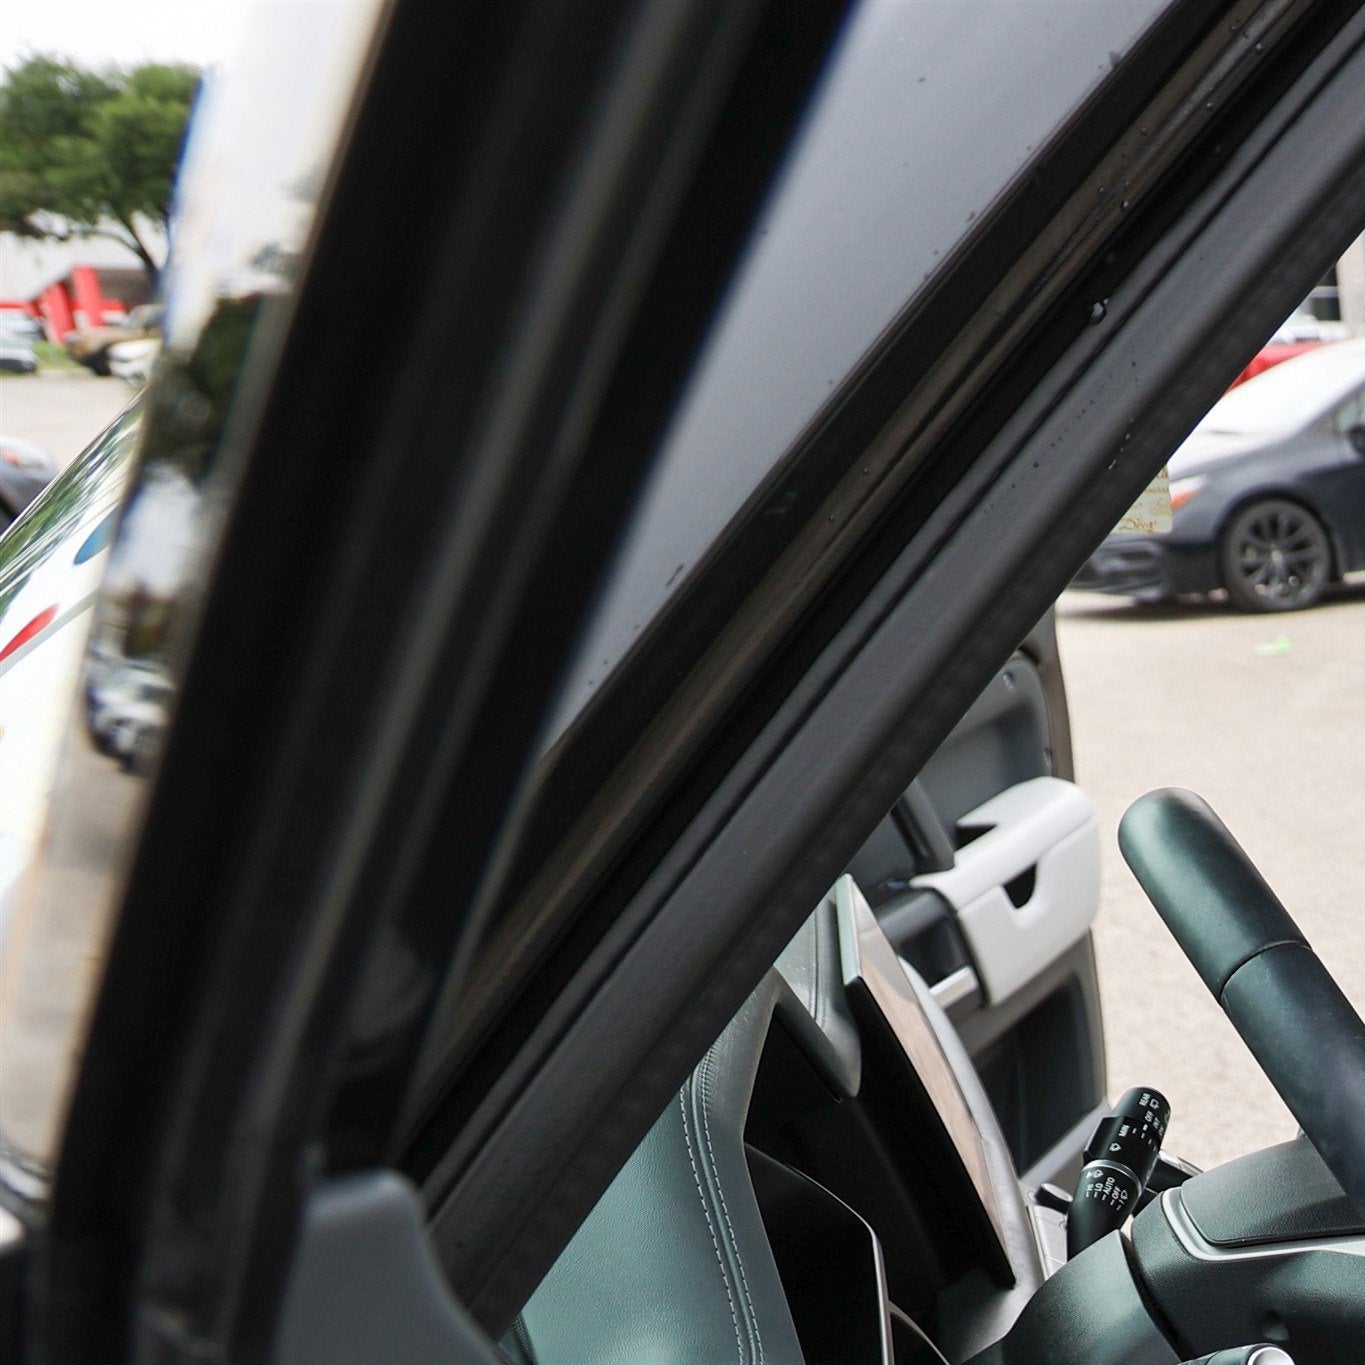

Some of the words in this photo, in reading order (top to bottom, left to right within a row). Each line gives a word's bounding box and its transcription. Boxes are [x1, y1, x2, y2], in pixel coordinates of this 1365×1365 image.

[1145, 1110, 1154, 1122] OFF
[1119, 1124, 1130, 1137] MIN
[1094, 1183, 1103, 1192] LO
[1103, 1176, 1115, 1195] AUTO
[1111, 1185, 1121, 1200] OFF
